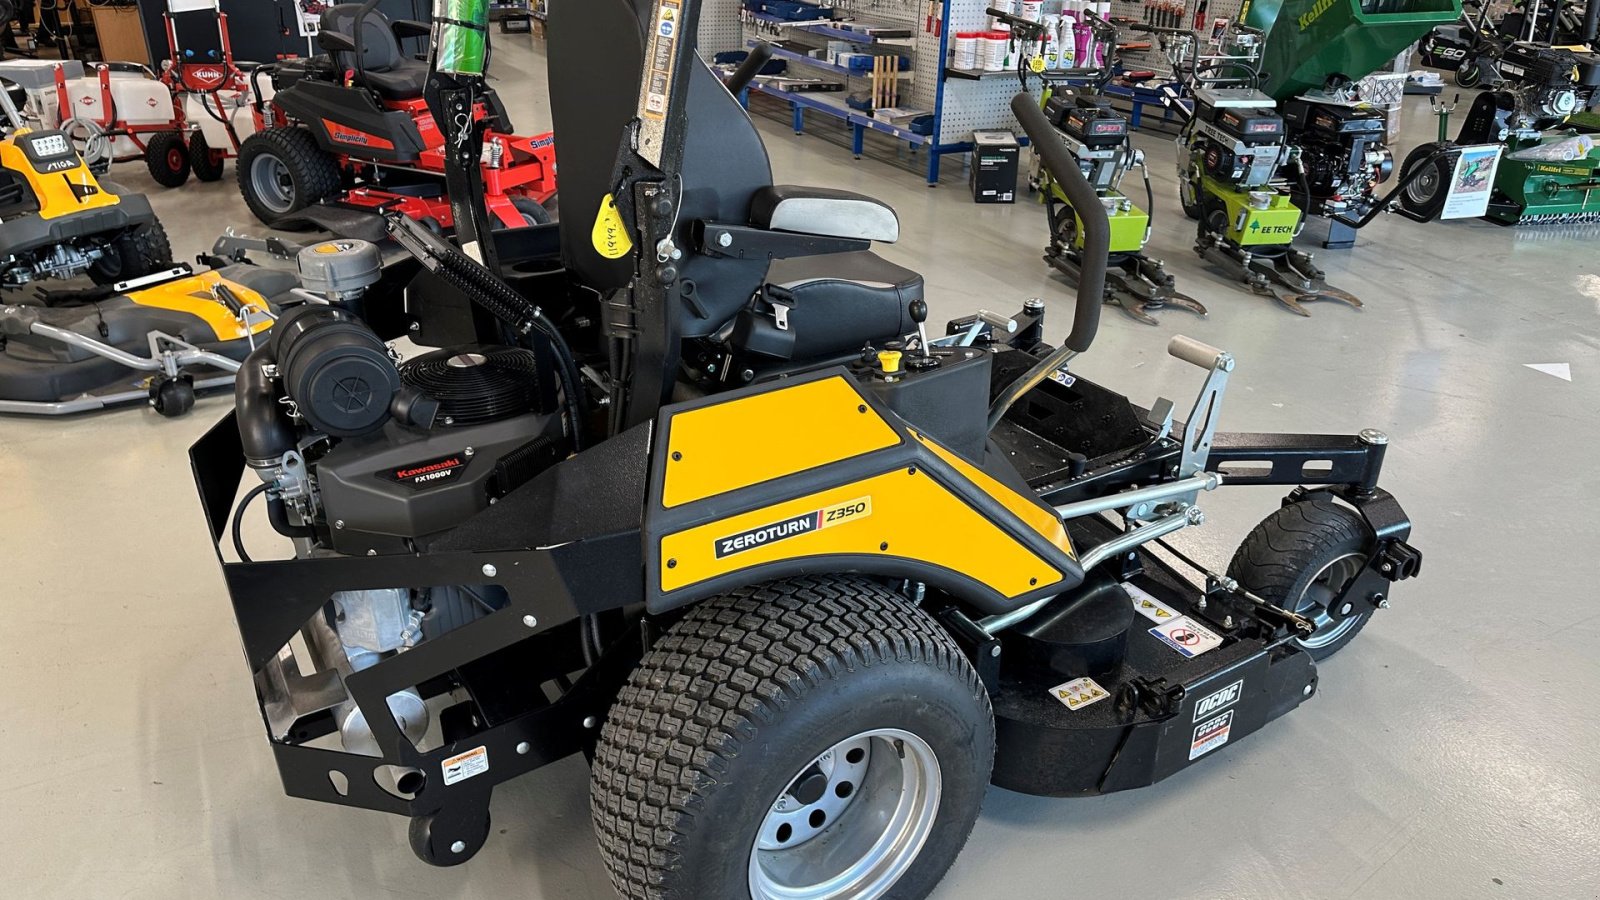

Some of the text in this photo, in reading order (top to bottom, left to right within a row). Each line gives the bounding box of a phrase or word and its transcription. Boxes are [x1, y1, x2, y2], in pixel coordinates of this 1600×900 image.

[1433, 46, 1467, 58] EGO
[334, 131, 368, 145] Simplicity
[47, 160, 75, 171] STIGA
[1540, 165, 1562, 173] Kellfri
[1261, 226, 1293, 234] EE TECH
[397, 458, 460, 478] Kawasaki
[415, 469, 452, 483] FX1000V
[722, 502, 866, 553] ZEROTURN Z350
[1197, 684, 1239, 716] OCDC
